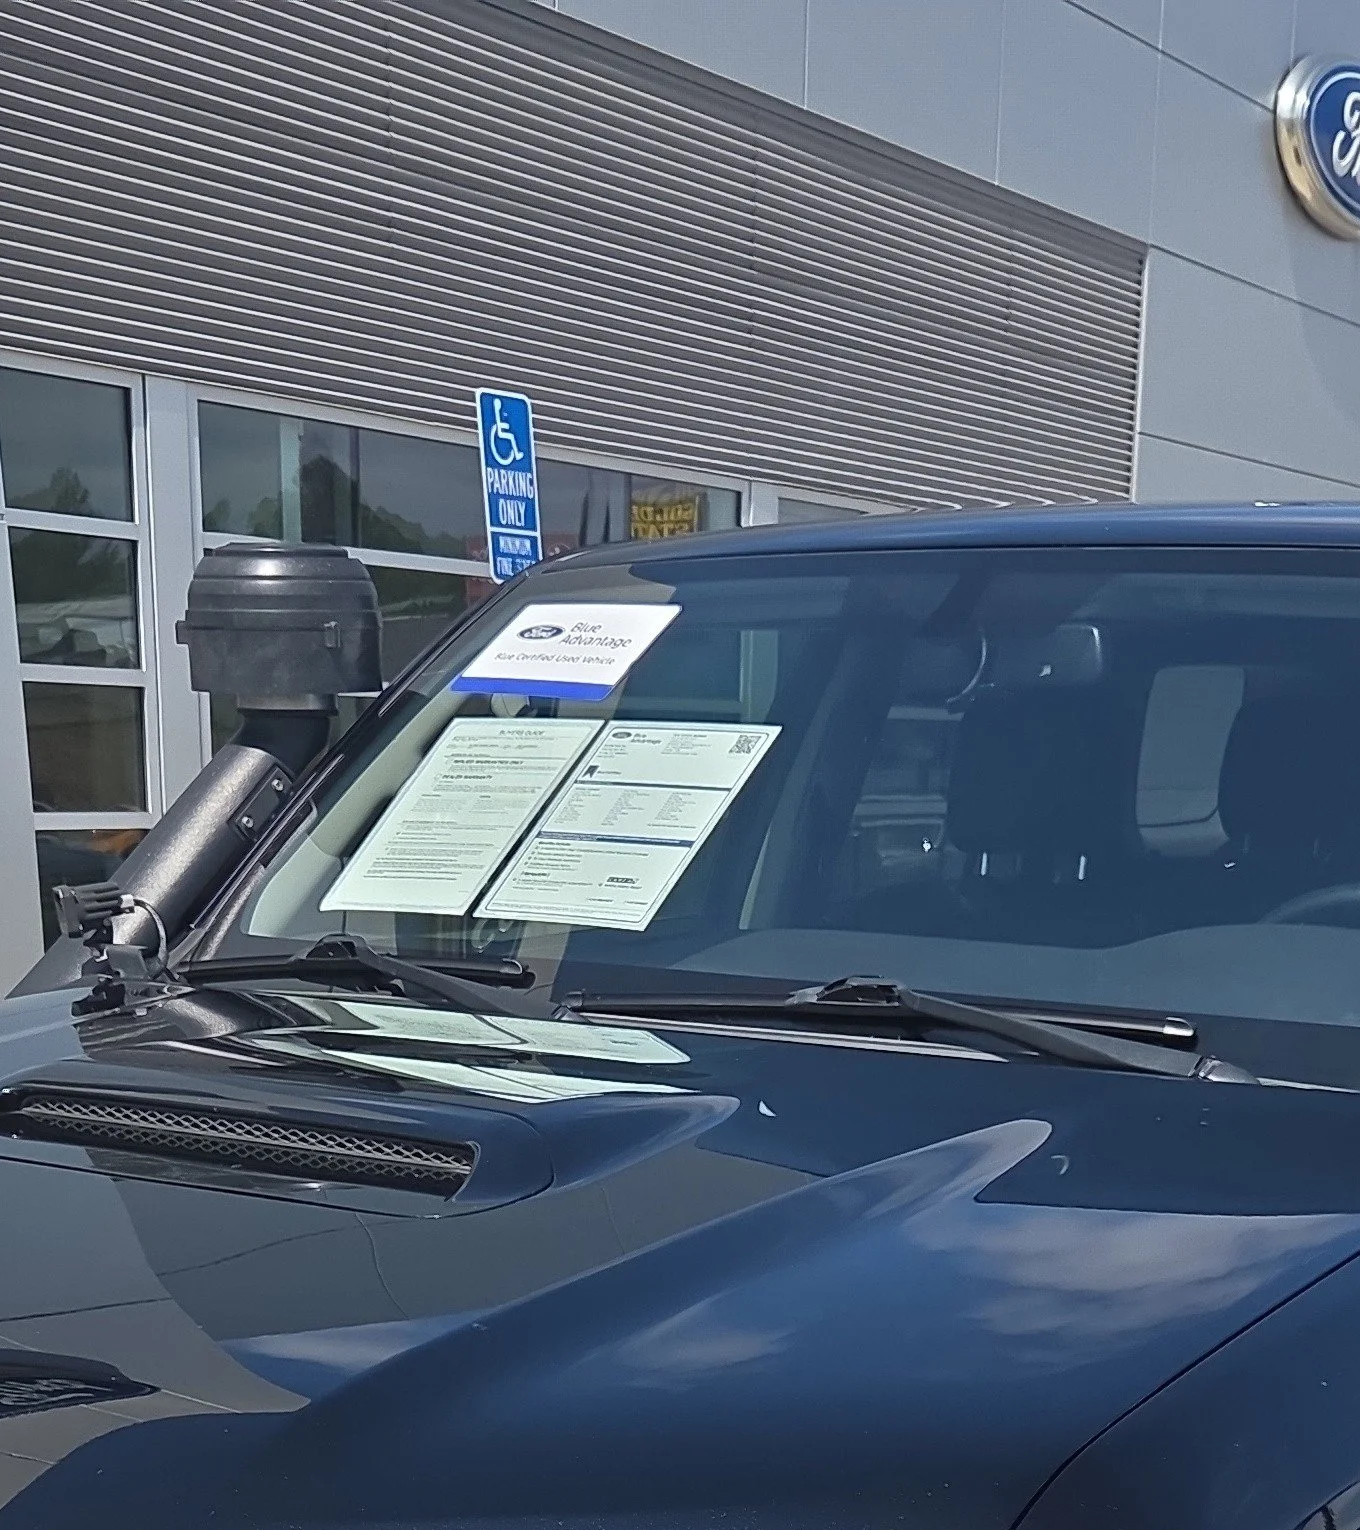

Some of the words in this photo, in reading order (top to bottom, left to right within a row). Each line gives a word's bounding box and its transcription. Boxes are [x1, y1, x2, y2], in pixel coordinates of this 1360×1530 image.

[486, 467, 534, 499] PARKING
[498, 498, 526, 527] ONLY
[570, 622, 602, 634] Blue
[559, 634, 633, 650] Advantage
[516, 652, 555, 662] Certified
[555, 654, 580, 664] Used
[581, 655, 615, 666] Vehicle
